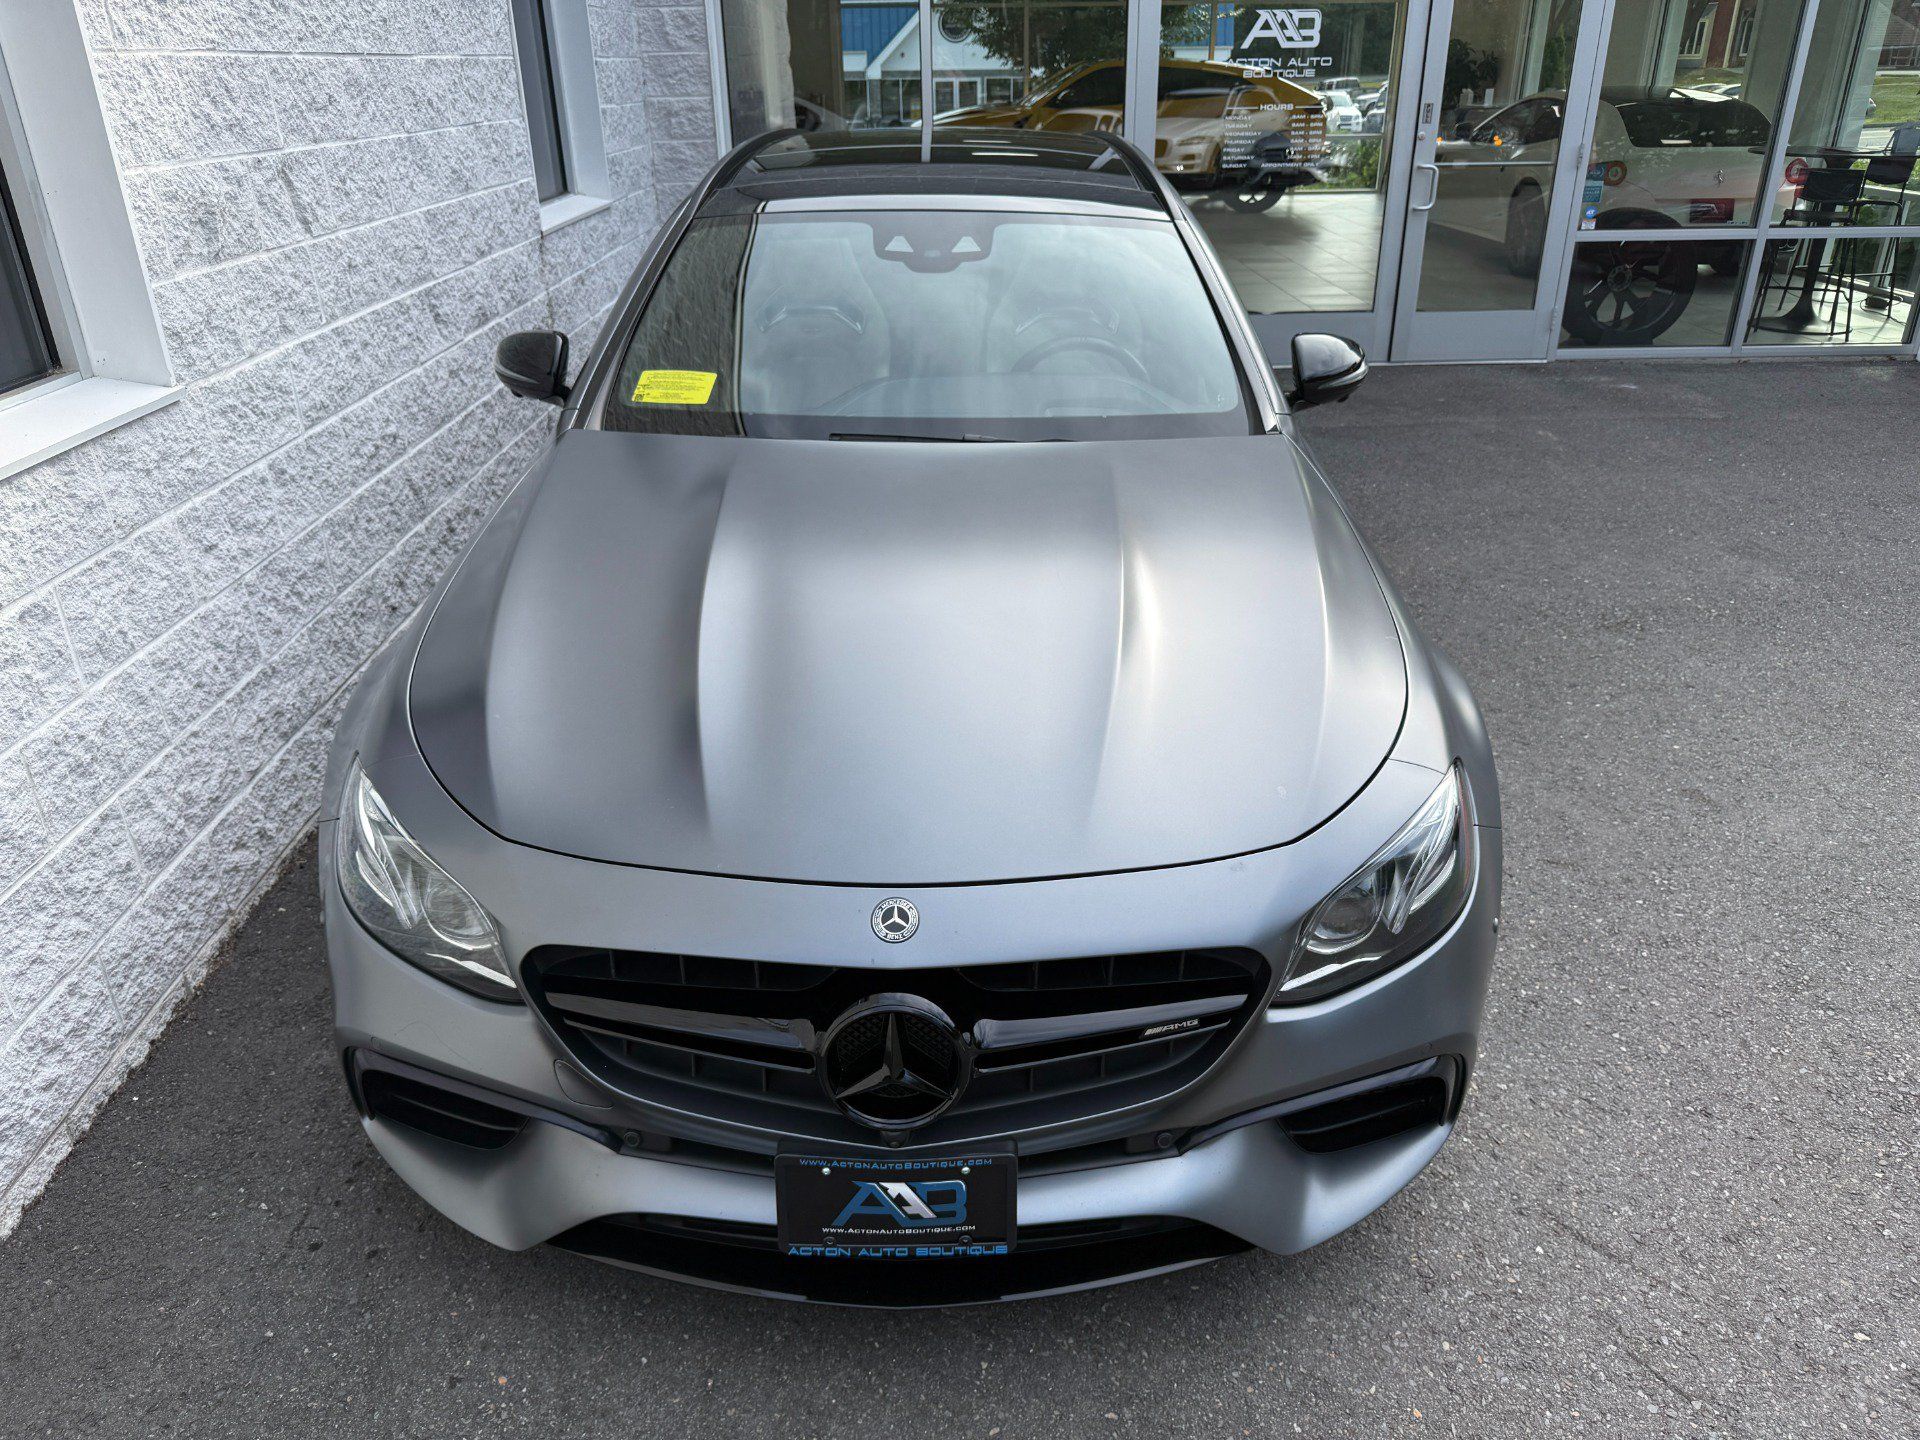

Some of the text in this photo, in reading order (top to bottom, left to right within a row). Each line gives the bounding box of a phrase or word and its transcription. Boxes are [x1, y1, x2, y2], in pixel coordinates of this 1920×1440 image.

[1226, 56, 1333, 67] ACTON AUTO
[1242, 68, 1316, 79] BOUTIQUE
[1259, 103, 1294, 111] HOURS
[1162, 1019, 1199, 1031] AMG
[787, 1244, 1008, 1257] ACTON AUTO BOUTIQUE
